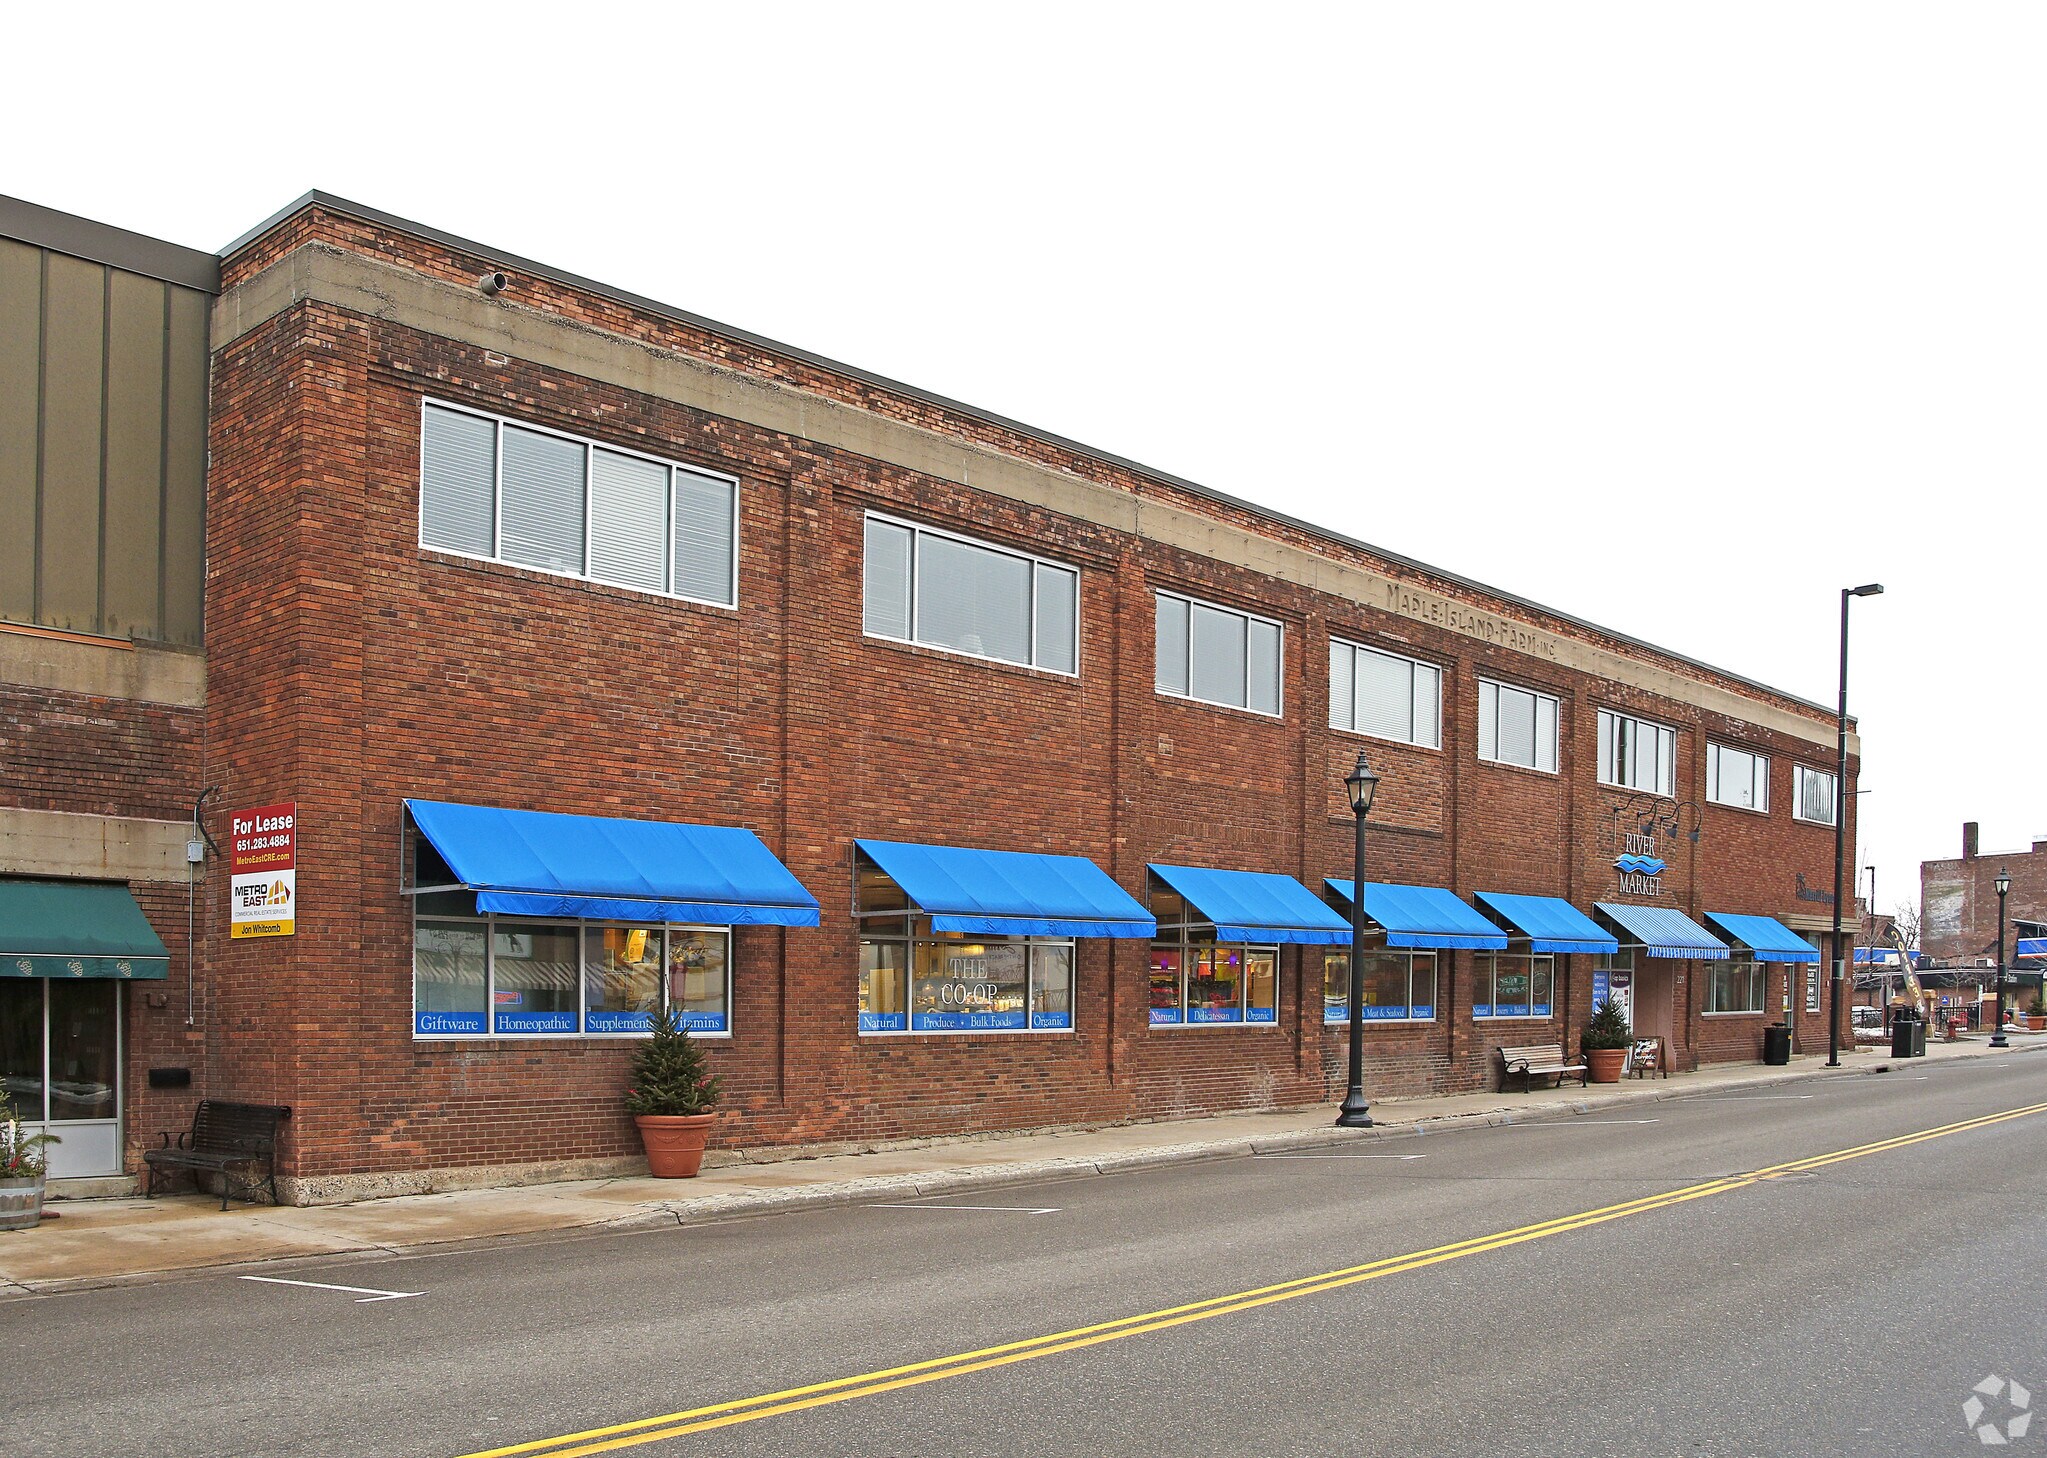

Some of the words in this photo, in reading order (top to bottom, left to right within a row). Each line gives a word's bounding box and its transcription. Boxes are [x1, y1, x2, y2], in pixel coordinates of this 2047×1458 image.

[233, 818, 253, 836] For
[256, 815, 293, 833] Lease
[237, 834, 290, 852] 651.283.4884
[1626, 832, 1655, 857] RIVER
[236, 853, 290, 866] MetroEastCRE.com
[235, 884, 268, 897] METRO
[1619, 872, 1662, 896] MARKET
[243, 895, 267, 907] EAST
[242, 925, 252, 935] Jon
[253, 923, 281, 934] Whitcomb
[950, 958, 988, 979] THE
[941, 983, 998, 1005] CO-OP
[1151, 1011, 1177, 1022] Natural
[1246, 1010, 1270, 1020] Organic
[1367, 1008, 1379, 1018] Meat
[1380, 1008, 1387, 1018] &
[1387, 1007, 1405, 1018] Seafood
[1411, 1007, 1429, 1018] Organic
[421, 1015, 478, 1031] Giftware
[498, 1016, 571, 1033] Homeopathic
[588, 1015, 656, 1031] Supplement
[864, 1016, 898, 1028] Natural
[923, 1016, 955, 1028] Produce
[971, 1015, 988, 1027] Bulk
[991, 1015, 1012, 1027] Foods
[1033, 1014, 1063, 1028] Organic
